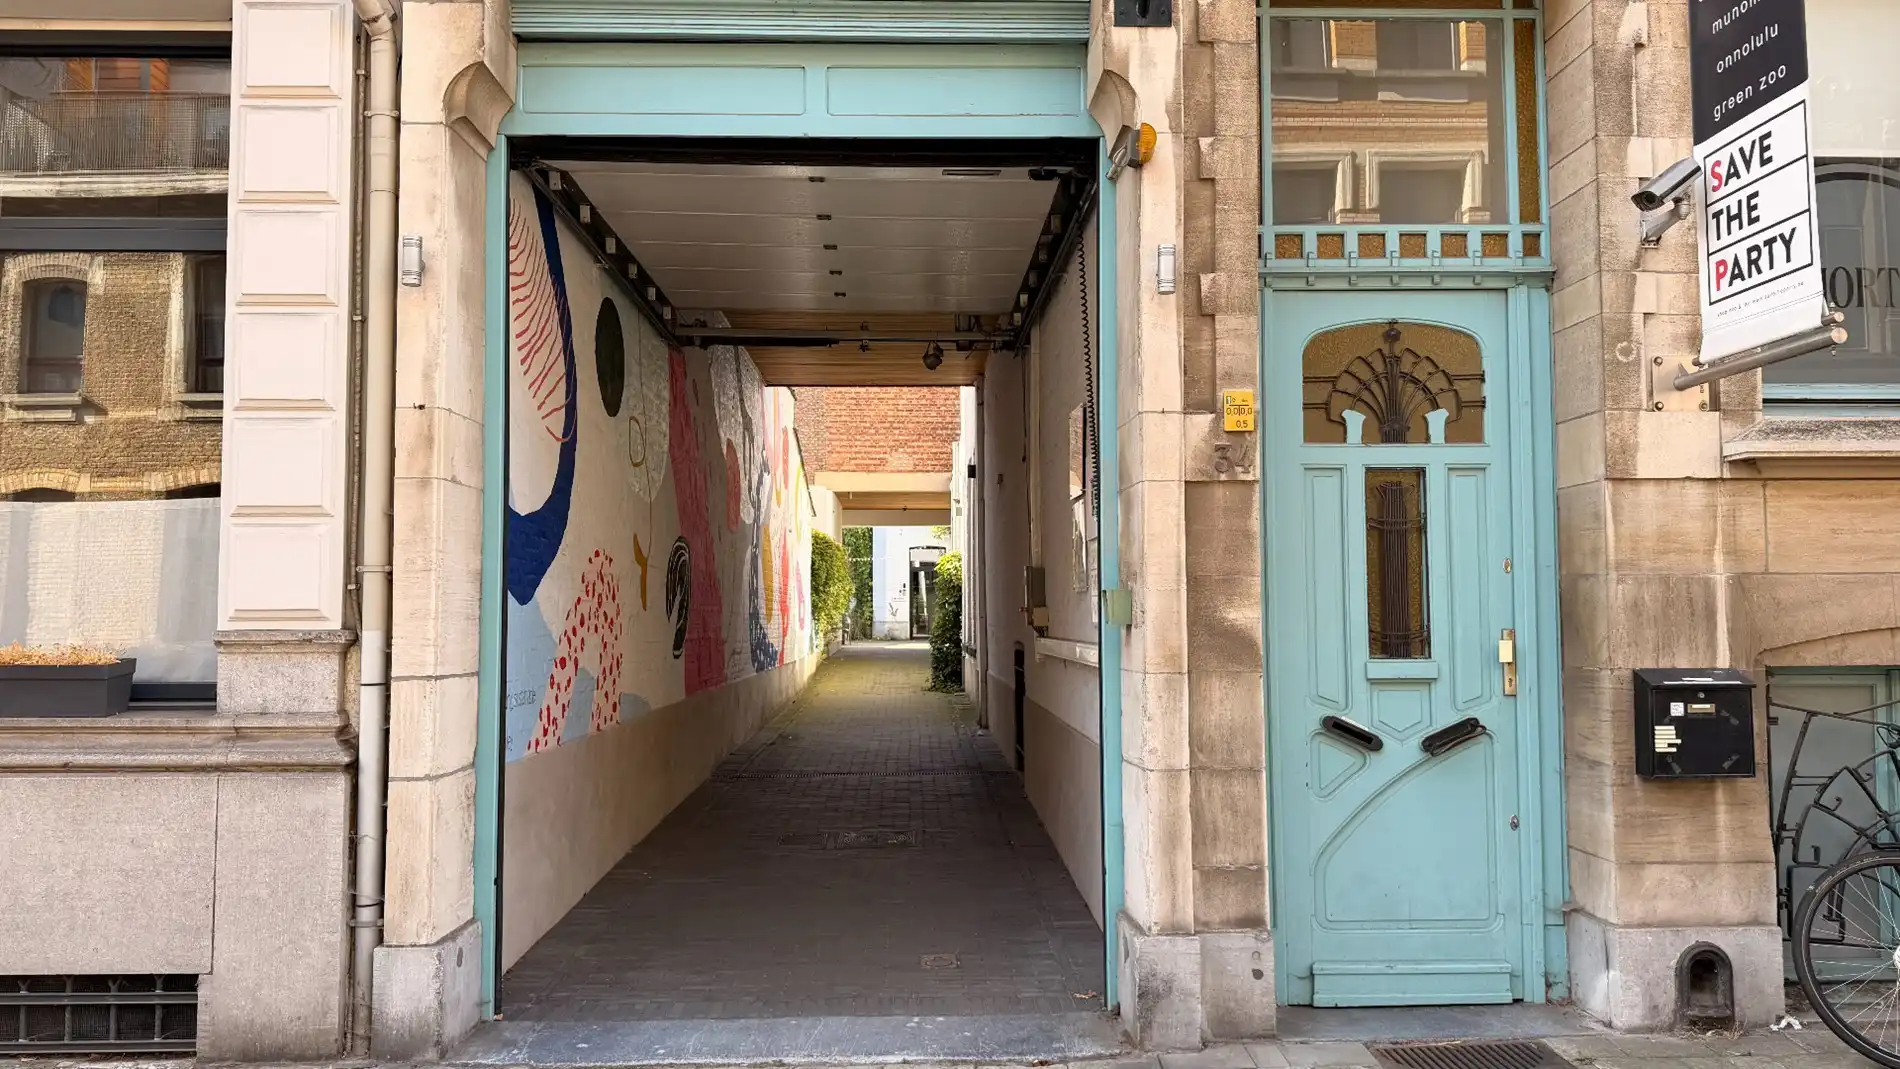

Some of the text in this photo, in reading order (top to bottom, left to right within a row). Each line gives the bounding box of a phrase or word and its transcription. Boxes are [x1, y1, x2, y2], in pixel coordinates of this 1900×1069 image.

[1716, 23, 1779, 73] onnolulu
[1713, 65, 1787, 122] green zoo
[1710, 130, 1773, 192] SAVE
[1711, 190, 1761, 241] THE
[1715, 227, 1797, 292] PARTY
[1214, 444, 1253, 474] 34
